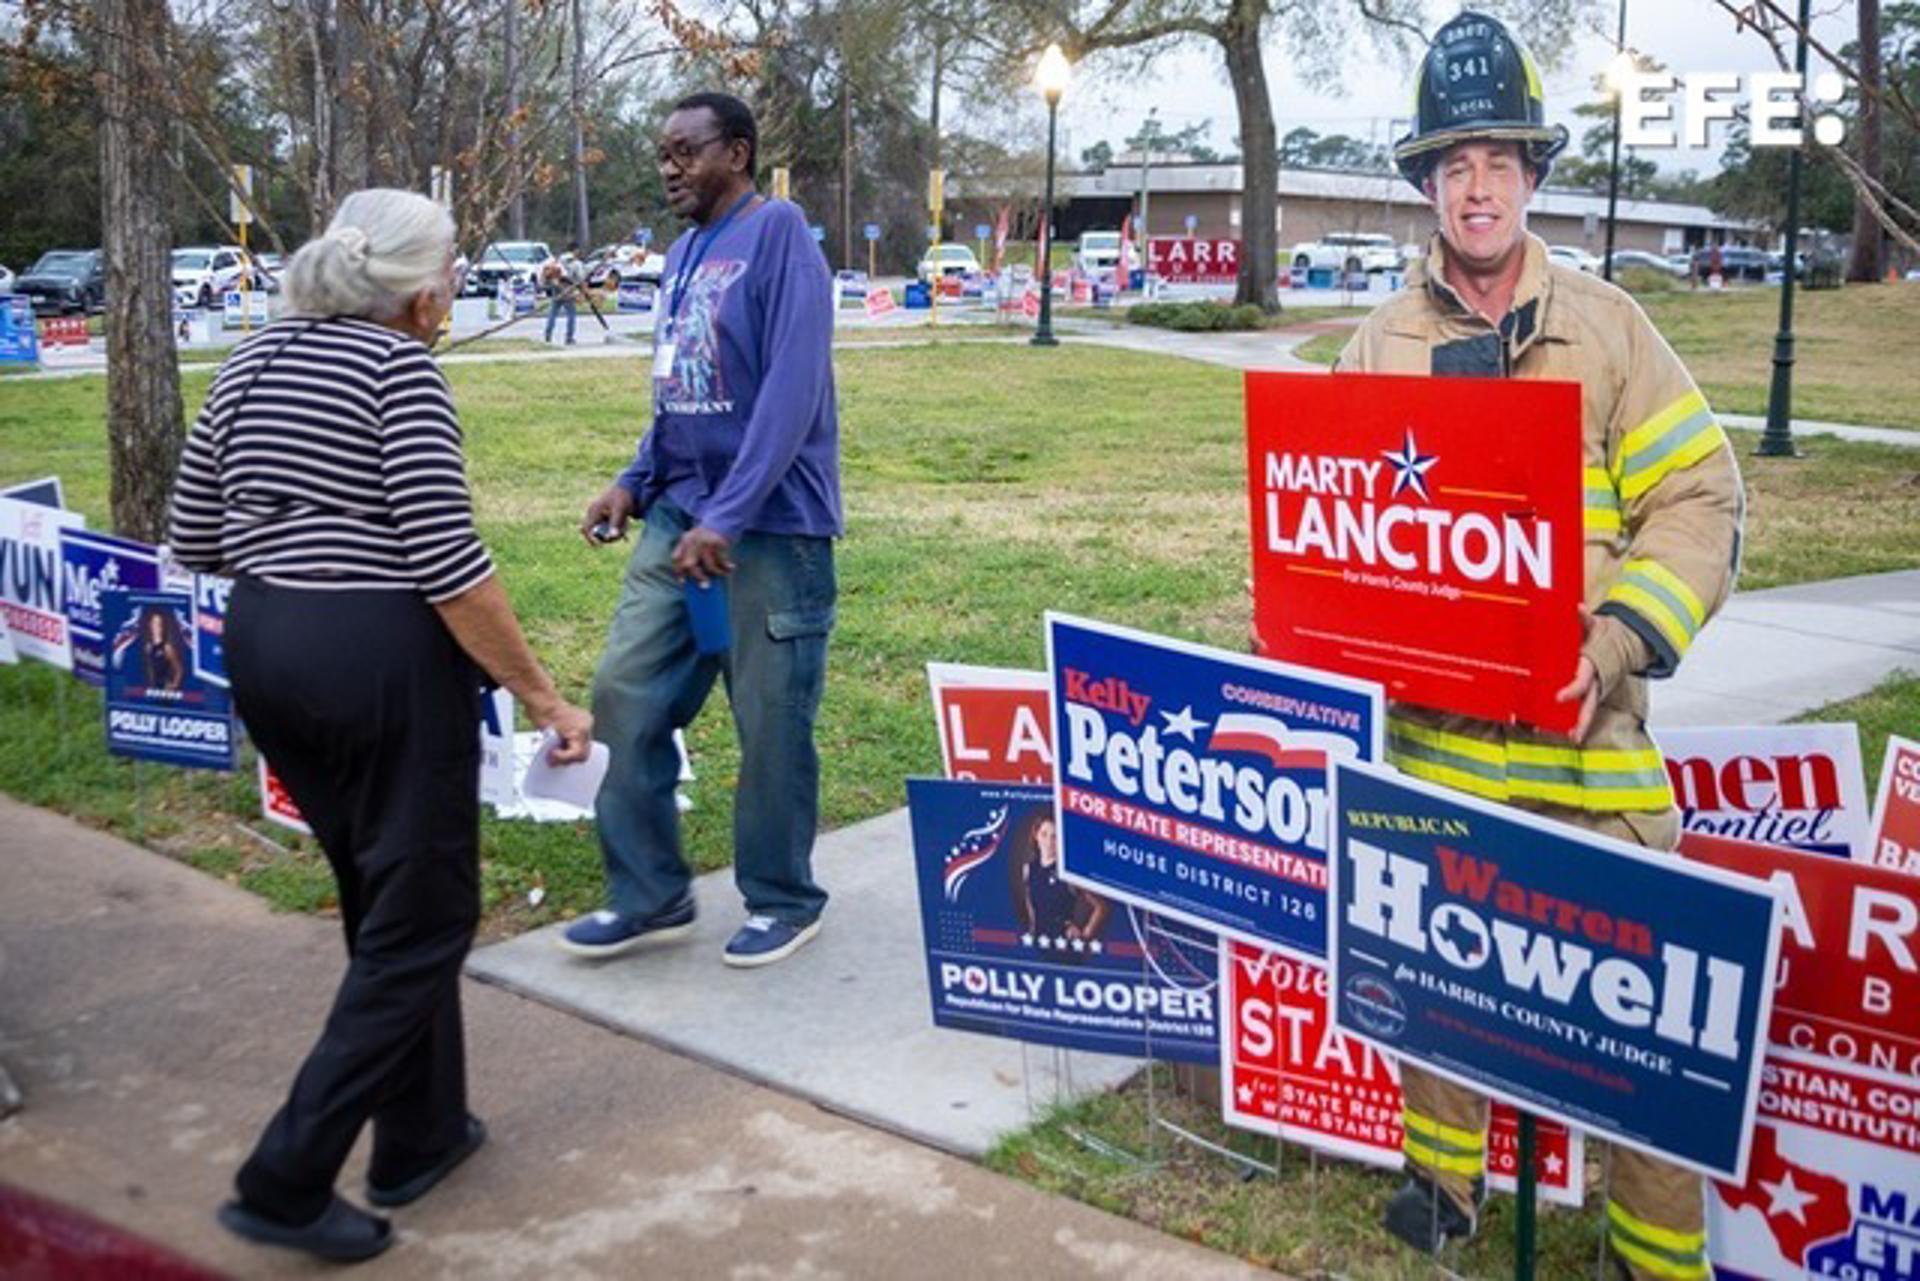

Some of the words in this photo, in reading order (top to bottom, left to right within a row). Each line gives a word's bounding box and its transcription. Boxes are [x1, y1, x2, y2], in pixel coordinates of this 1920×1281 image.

[1448, 55, 1490, 82] 341
[1148, 241, 1236, 262] LARR
[1265, 452, 1381, 499] MARTY
[1265, 491, 1553, 589] LANCTON
[1064, 667, 1151, 725] Kelly
[1220, 683, 1361, 732] CONSERVATIVE
[110, 710, 157, 738] POLLY
[160, 716, 230, 743] LOOPER
[949, 704, 1054, 764] LA
[1069, 790, 1108, 817] FOR
[1110, 803, 1173, 839] STATE
[1346, 809, 1471, 838] REPUBLICAN
[1103, 838, 1169, 875] HOUSE
[1174, 861, 1272, 907] DISTRICT
[1435, 844, 1655, 956] Warren
[1233, 950, 1328, 999] Vote
[1346, 837, 1745, 1061] Howell
[941, 962, 1045, 1002] POLLY
[1055, 977, 1215, 1021] LOOPER
[1419, 971, 1498, 1014] HARRIS
[1501, 1001, 1595, 1047] COUNTY
[1595, 1035, 1673, 1077] JUDGE
[1280, 1084, 1343, 1113] STATE
[1759, 1091, 1920, 1148] ONSTITUTI
